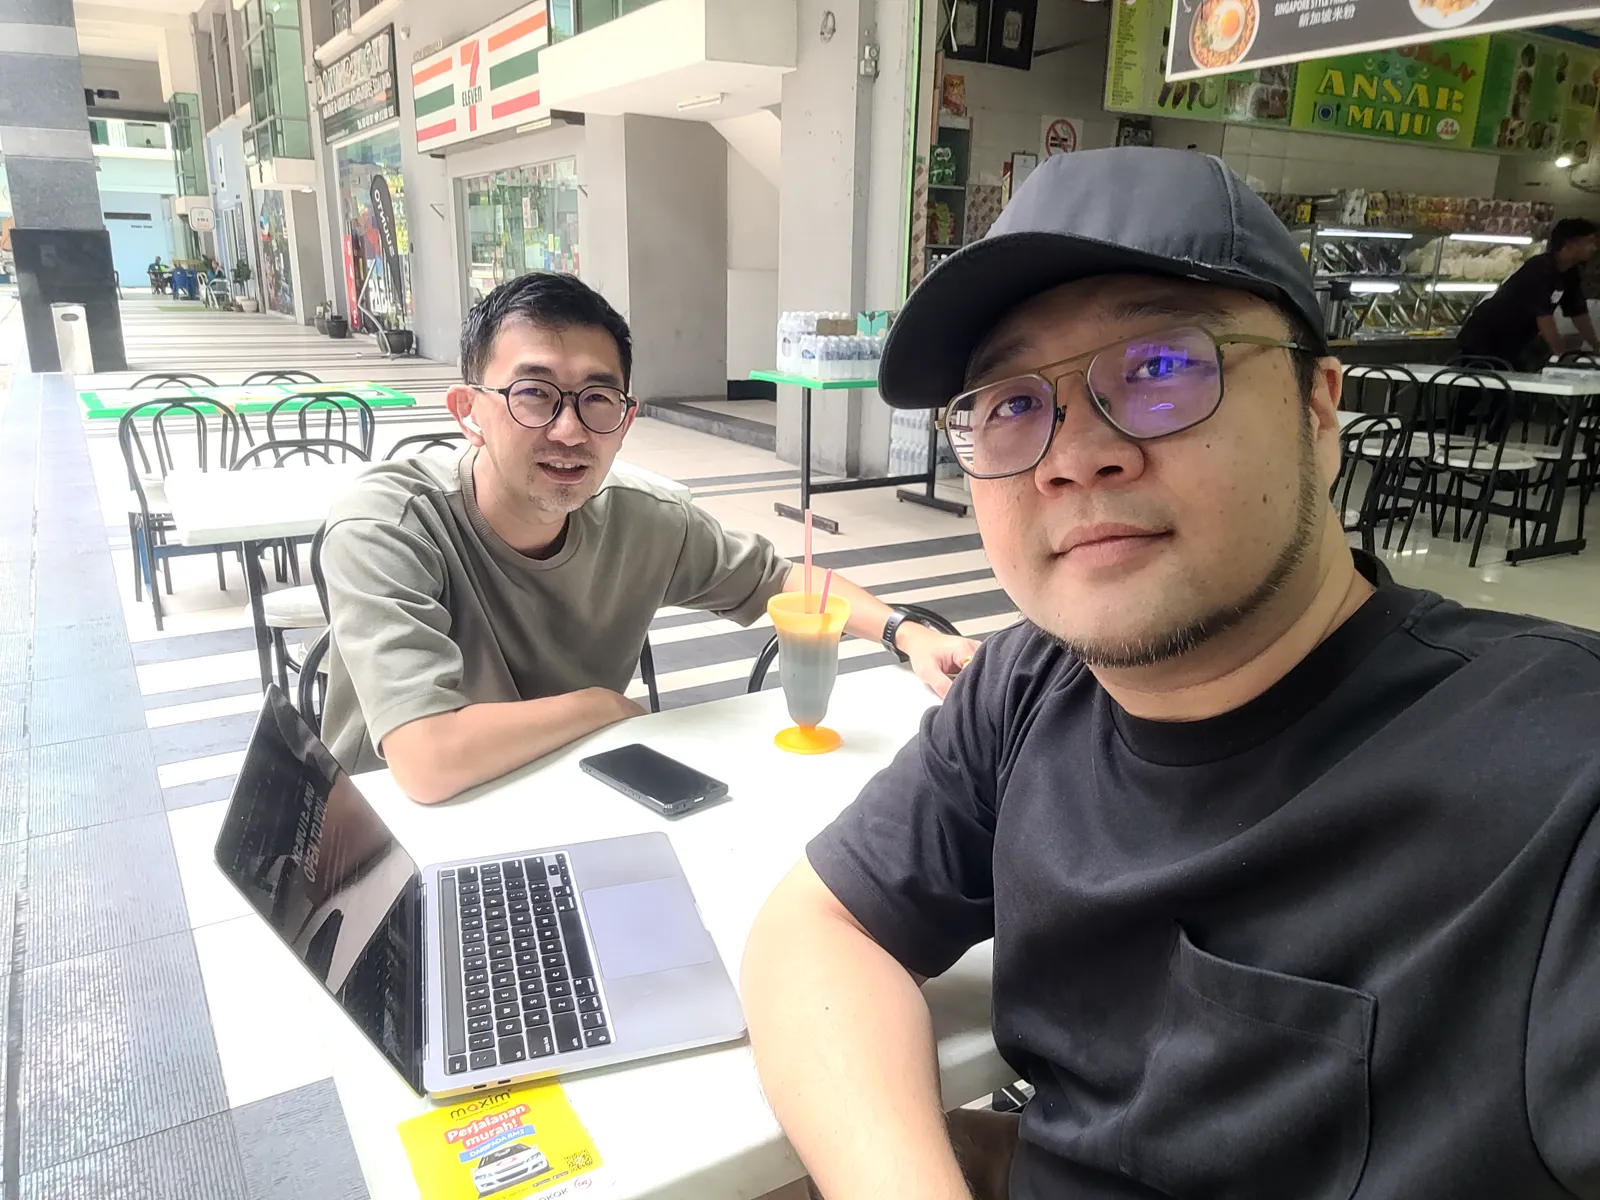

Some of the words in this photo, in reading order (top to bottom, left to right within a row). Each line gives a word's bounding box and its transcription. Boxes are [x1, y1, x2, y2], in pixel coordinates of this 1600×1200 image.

[1274, 0, 1310, 16] SINGAPORE
[1298, 3, 1356, 28] 新加坡米粉
[460, 39, 480, 132] 7
[1347, 104, 1431, 136] MAJU
[303, 836, 322, 883] OPEN
[447, 1105, 526, 1142] Perjalanan
[465, 1118, 519, 1147] murah!
